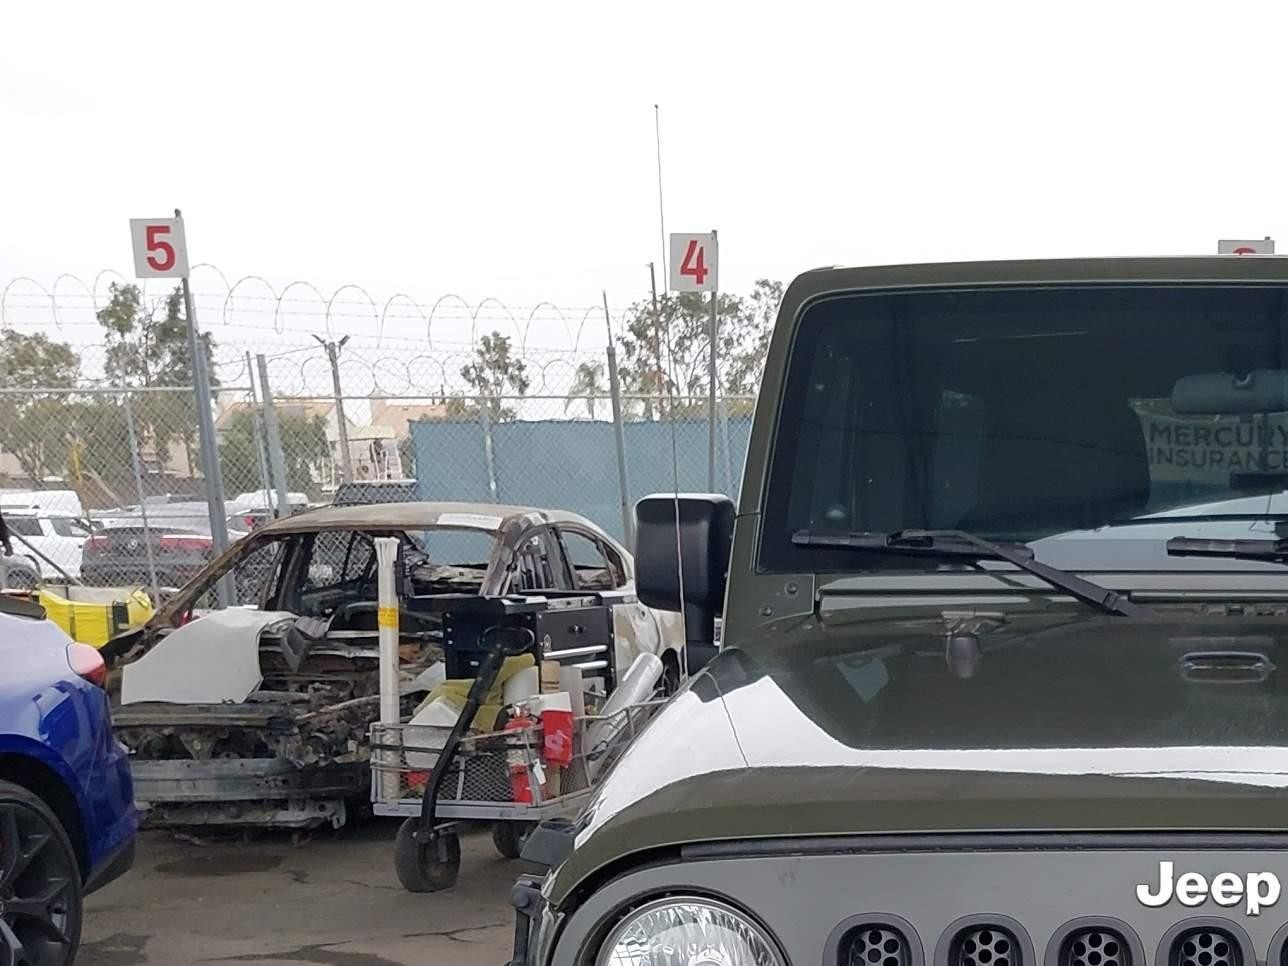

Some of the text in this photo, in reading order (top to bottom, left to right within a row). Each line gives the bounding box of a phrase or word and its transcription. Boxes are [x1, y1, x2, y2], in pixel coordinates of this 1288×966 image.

[146, 225, 176, 272] 5
[680, 239, 708, 285] 4
[1136, 861, 1281, 916] Jeep
